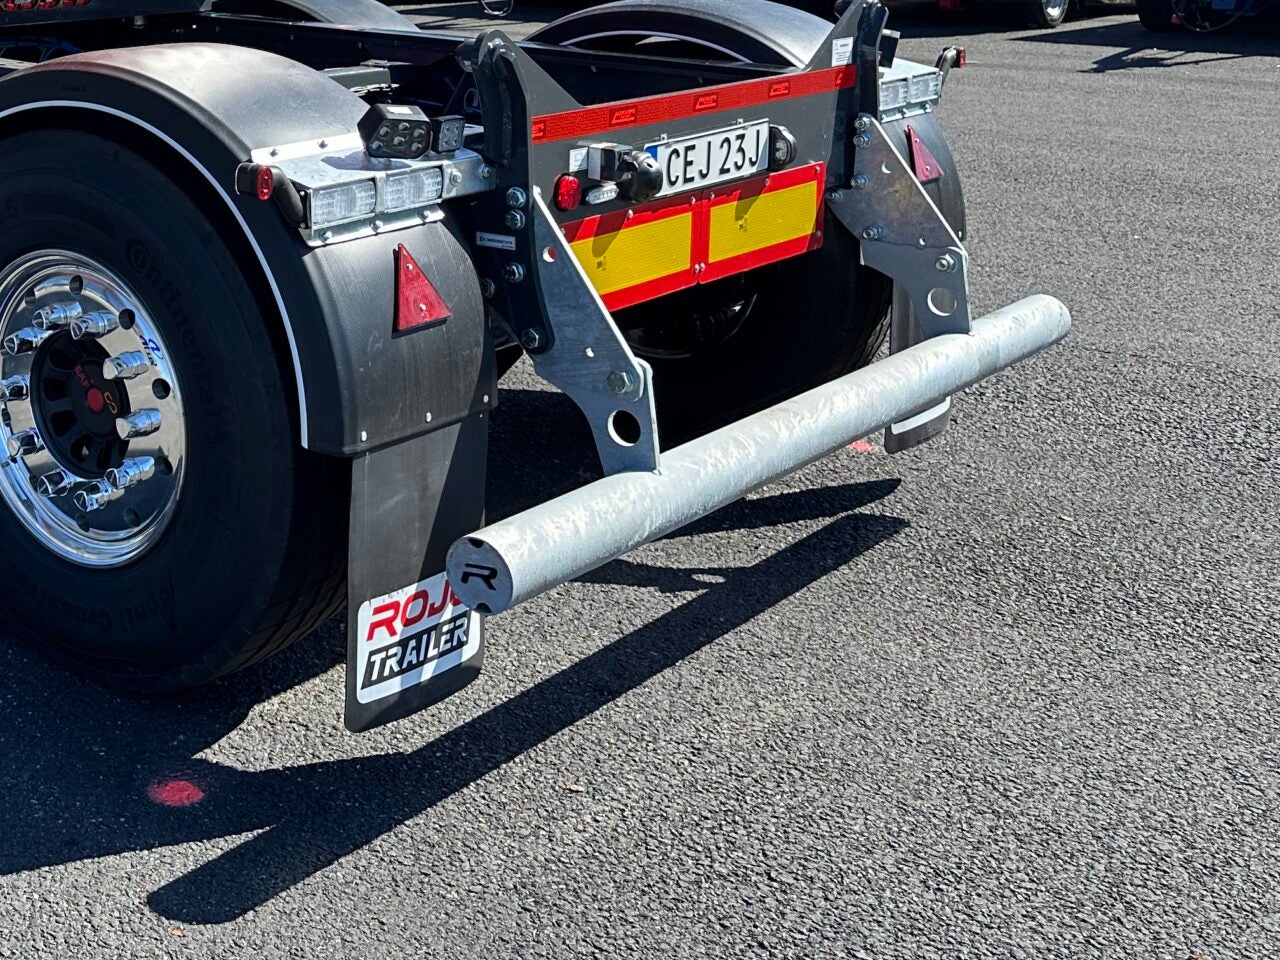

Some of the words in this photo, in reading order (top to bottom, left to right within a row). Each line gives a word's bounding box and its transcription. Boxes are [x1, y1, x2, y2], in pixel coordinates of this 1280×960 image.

[666, 141, 712, 187] CEJ
[720, 129, 761, 174] 23J
[370, 617, 468, 681] TRAILER
